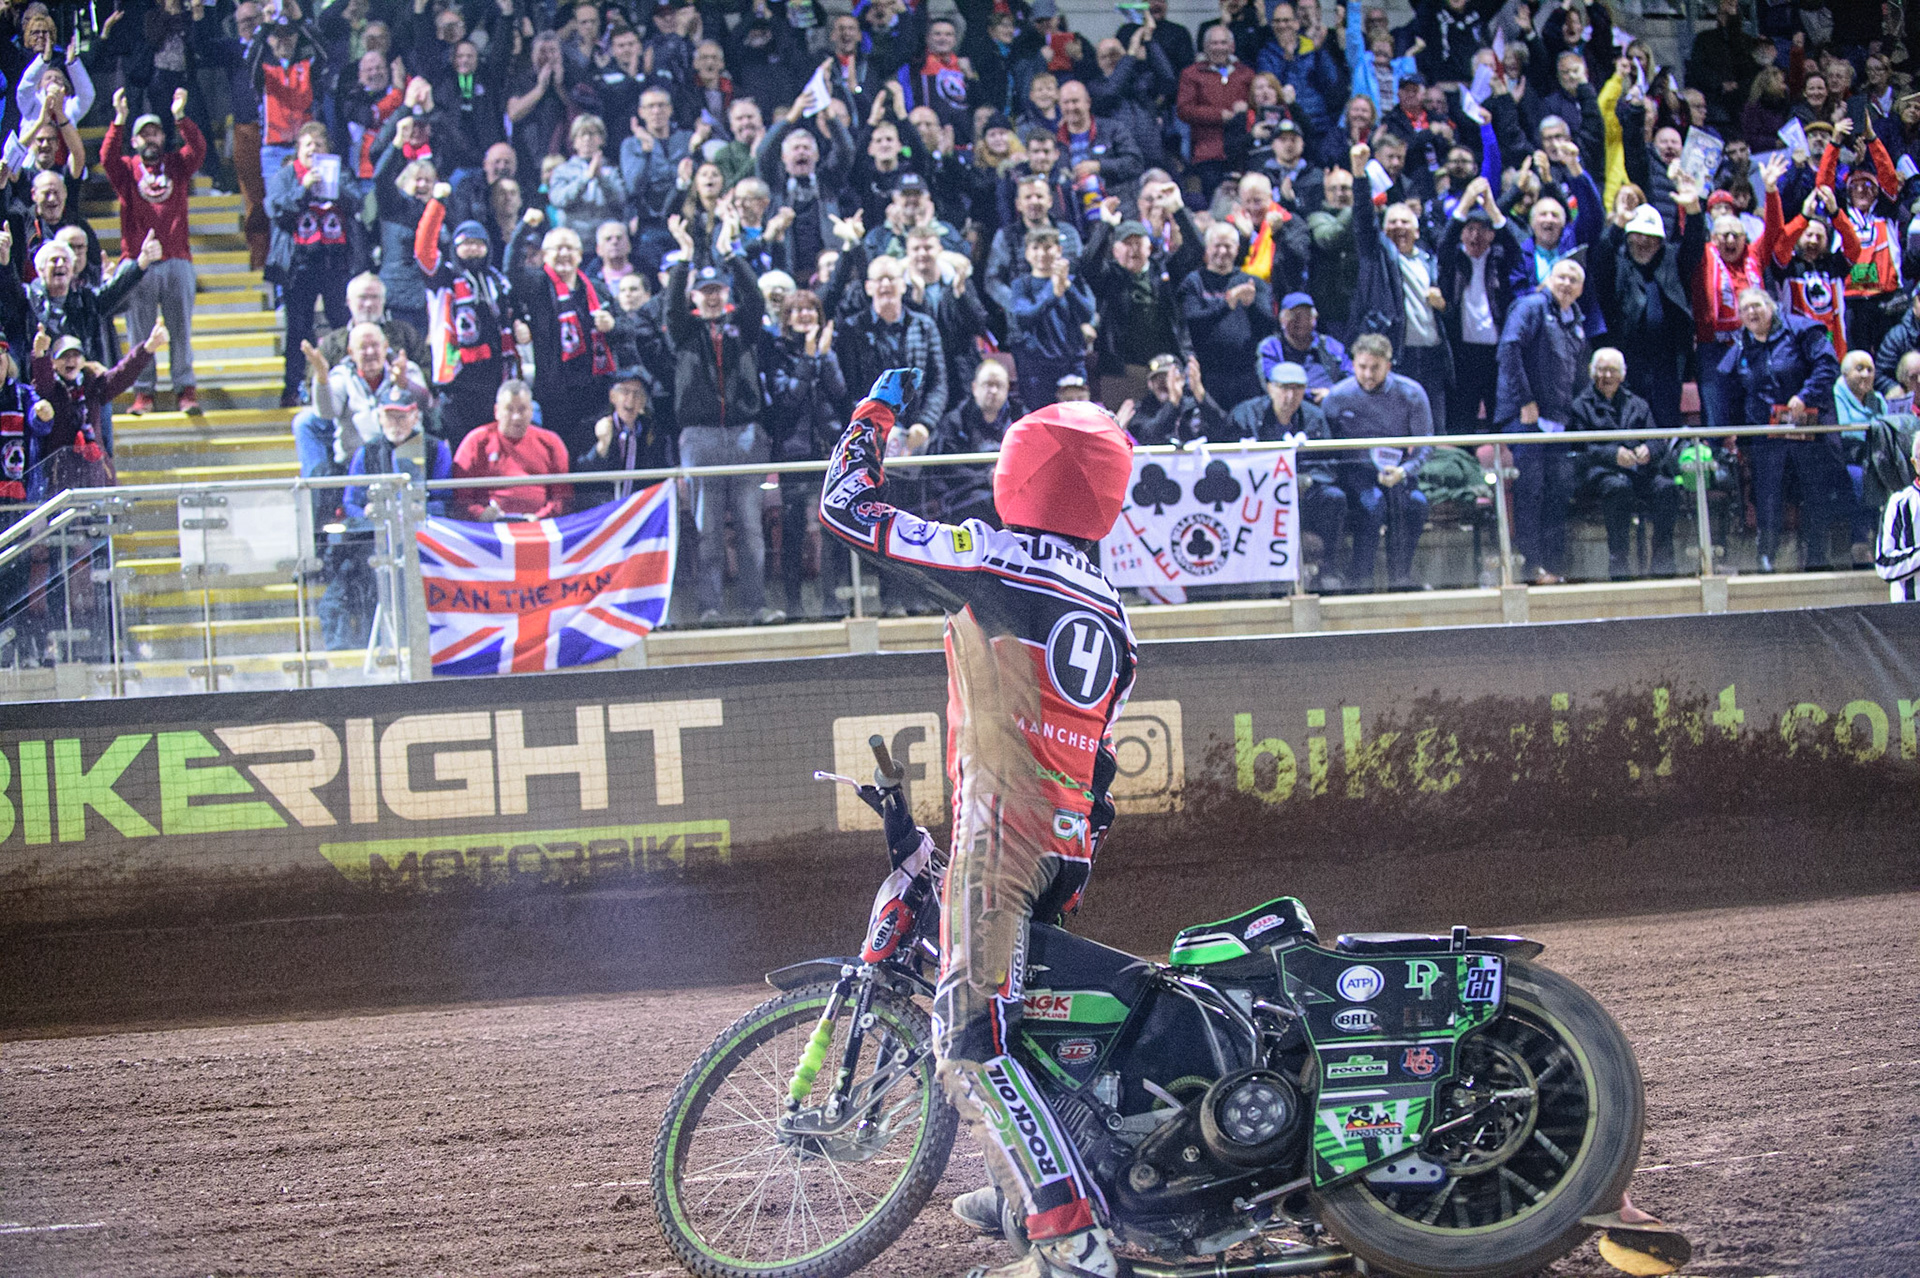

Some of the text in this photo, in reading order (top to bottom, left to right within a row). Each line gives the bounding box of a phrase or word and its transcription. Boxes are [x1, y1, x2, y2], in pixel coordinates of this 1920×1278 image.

[1233, 468, 1269, 556] VUE
[1269, 454, 1293, 567] ACES
[428, 572, 611, 611] DAN THE MAN
[1068, 622, 1105, 698] 4
[0, 698, 723, 845] IKERIGHT
[1346, 977, 1374, 989] ATPI
[1465, 968, 1497, 999] 26
[1061, 1045, 1092, 1056] STS
[987, 1064, 1059, 1176] ROCK OIL
